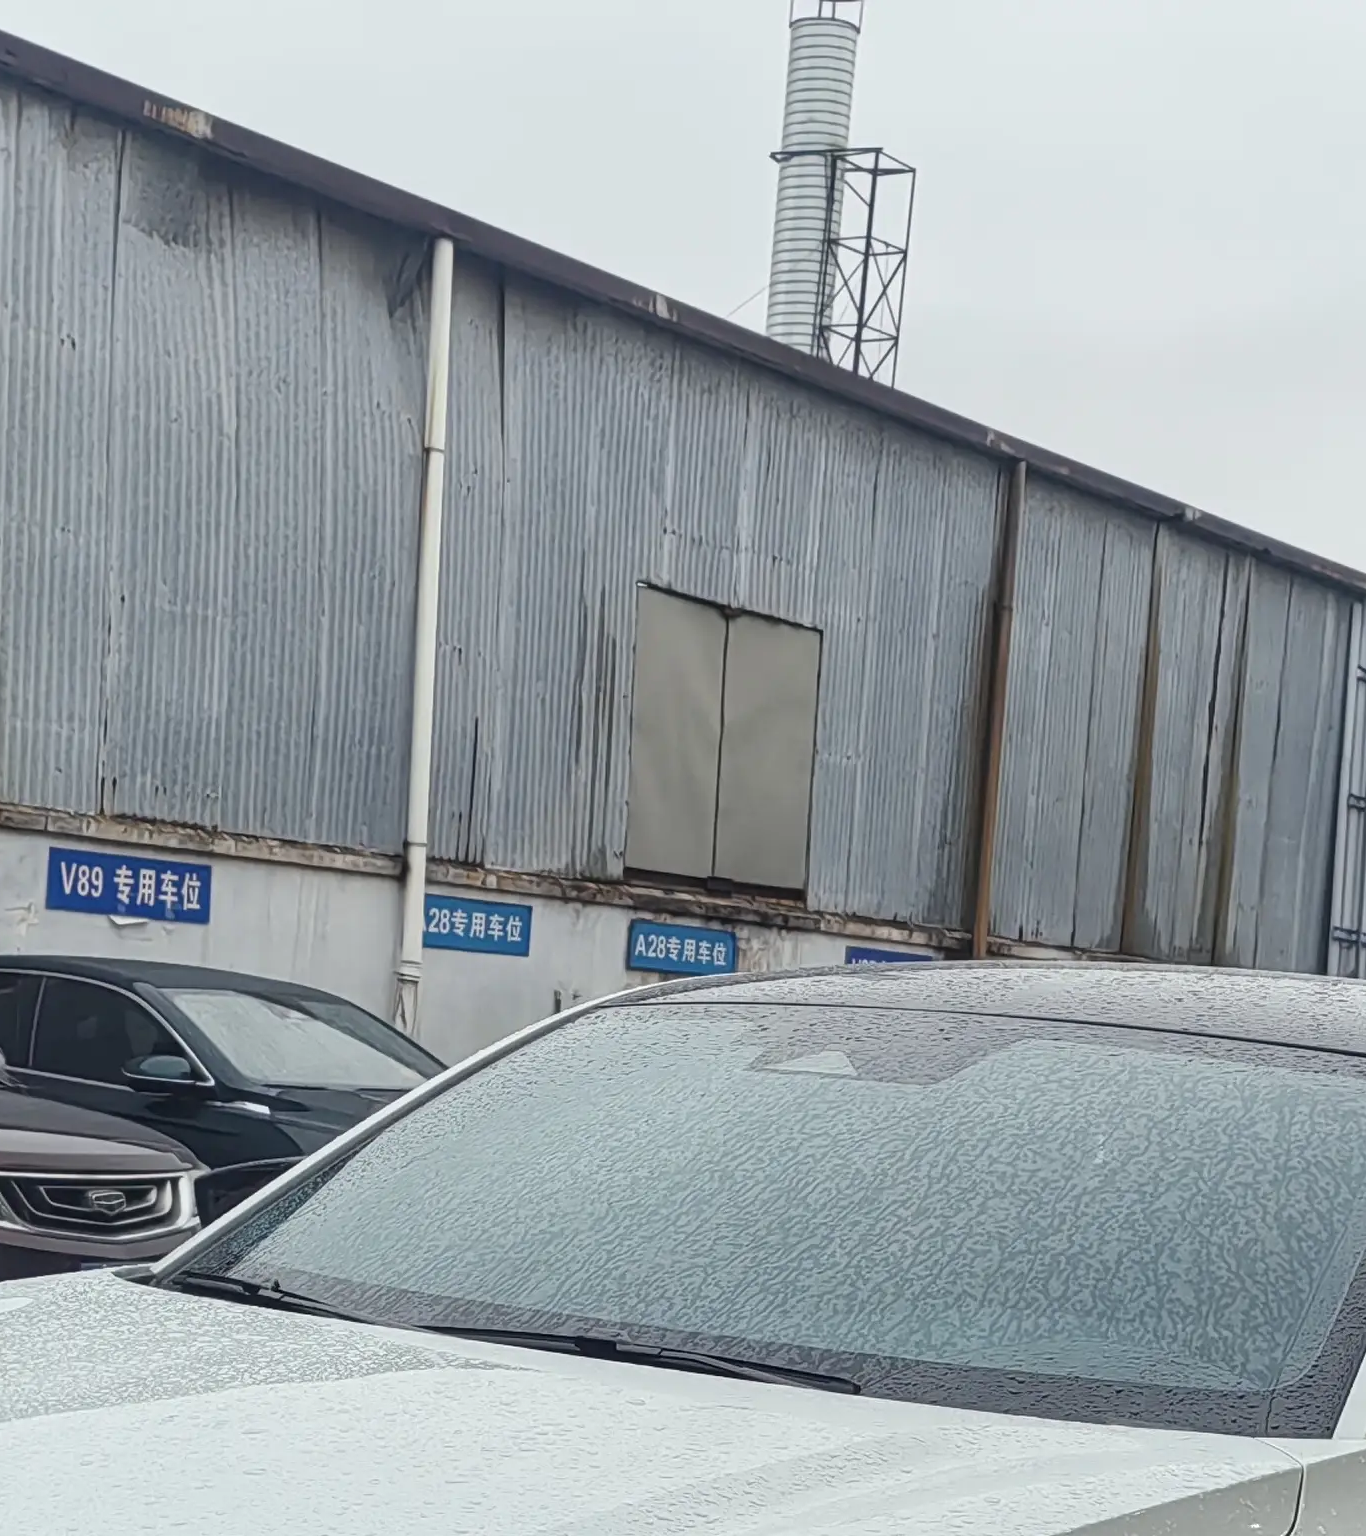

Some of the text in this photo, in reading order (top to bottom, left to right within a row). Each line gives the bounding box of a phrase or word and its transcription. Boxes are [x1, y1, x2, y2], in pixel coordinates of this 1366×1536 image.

[60, 861, 202, 911] V89 专用车位
[423, 907, 523, 943] 28专用车位
[634, 934, 728, 966] A28专用车位
